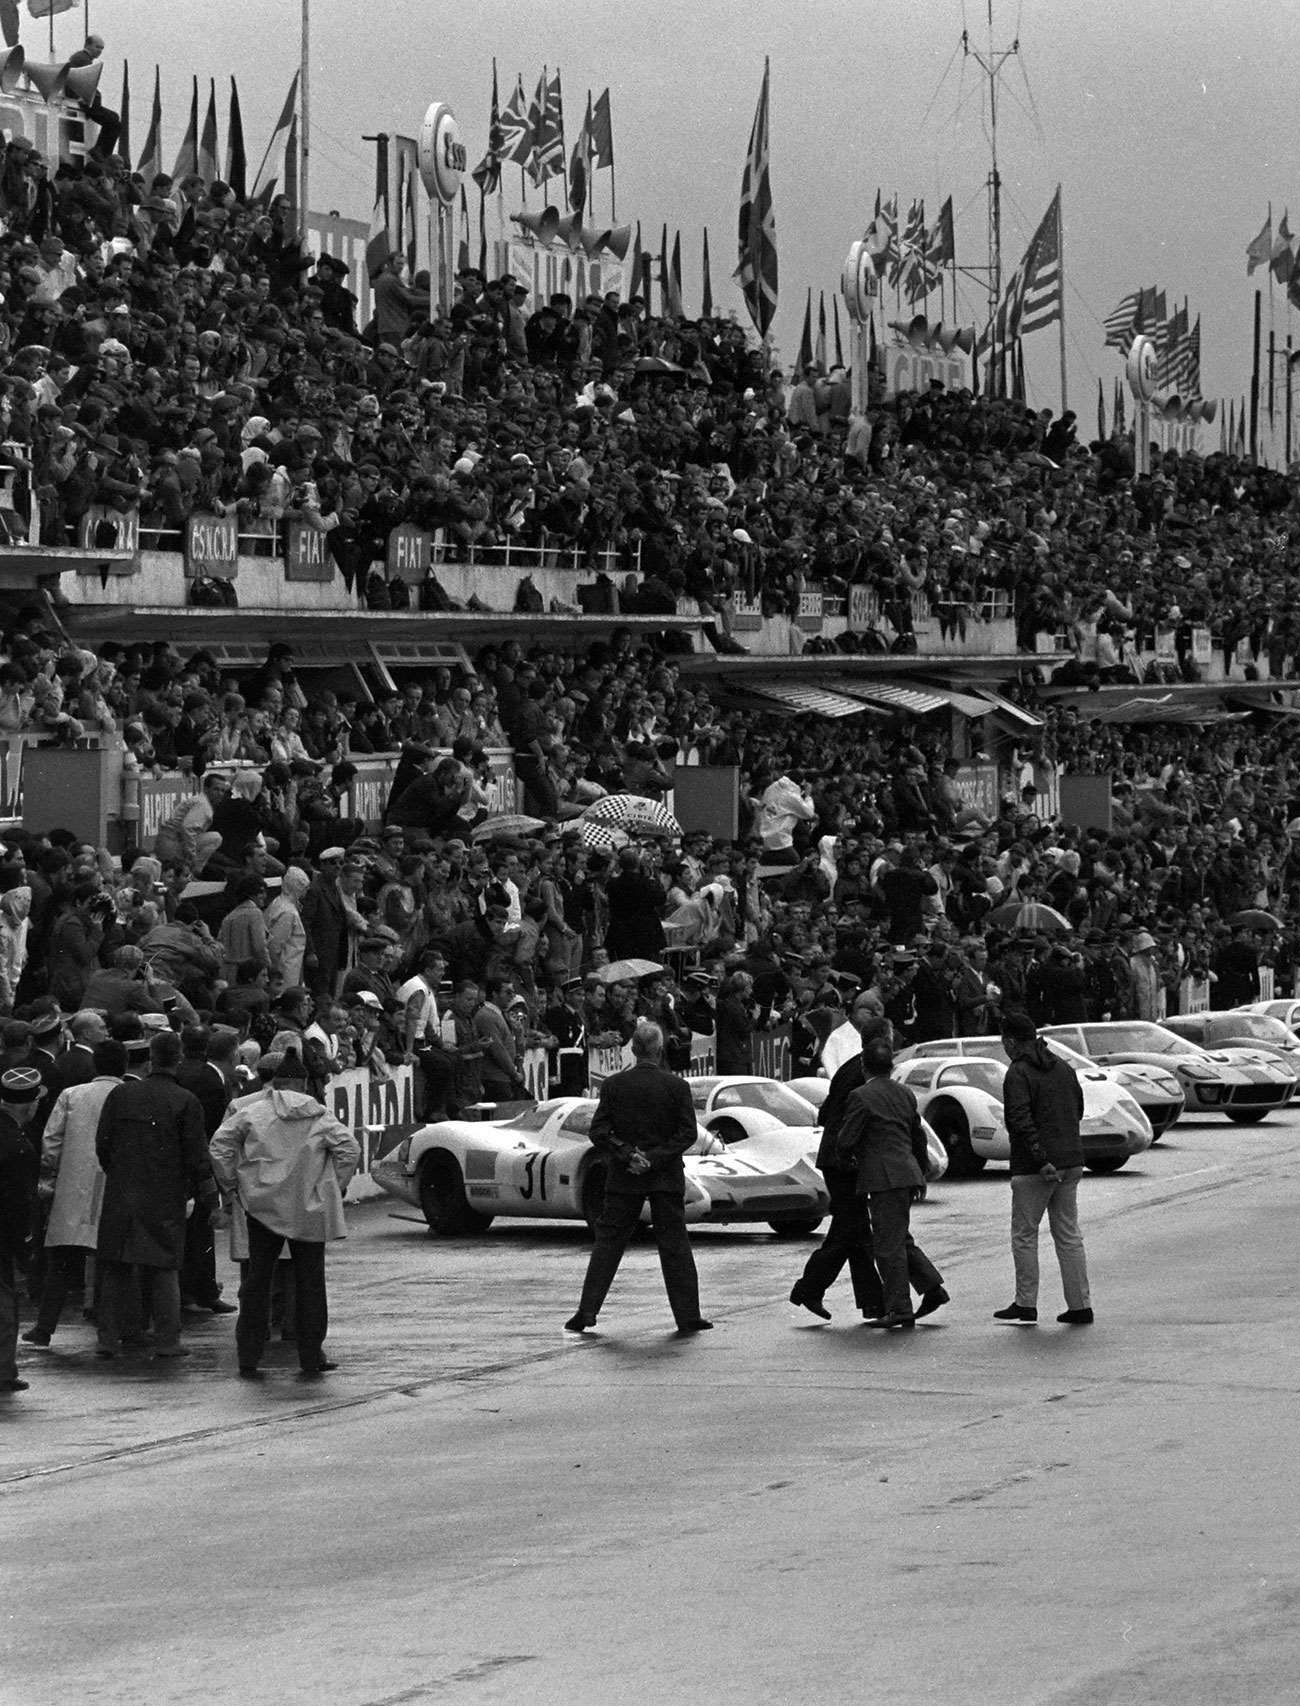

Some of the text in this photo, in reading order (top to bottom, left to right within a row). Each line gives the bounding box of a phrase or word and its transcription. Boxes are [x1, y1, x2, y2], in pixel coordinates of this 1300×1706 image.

[299, 530, 327, 565] FIAT
[396, 536, 423, 569] FIAT
[519, 1151, 552, 1201] 31
